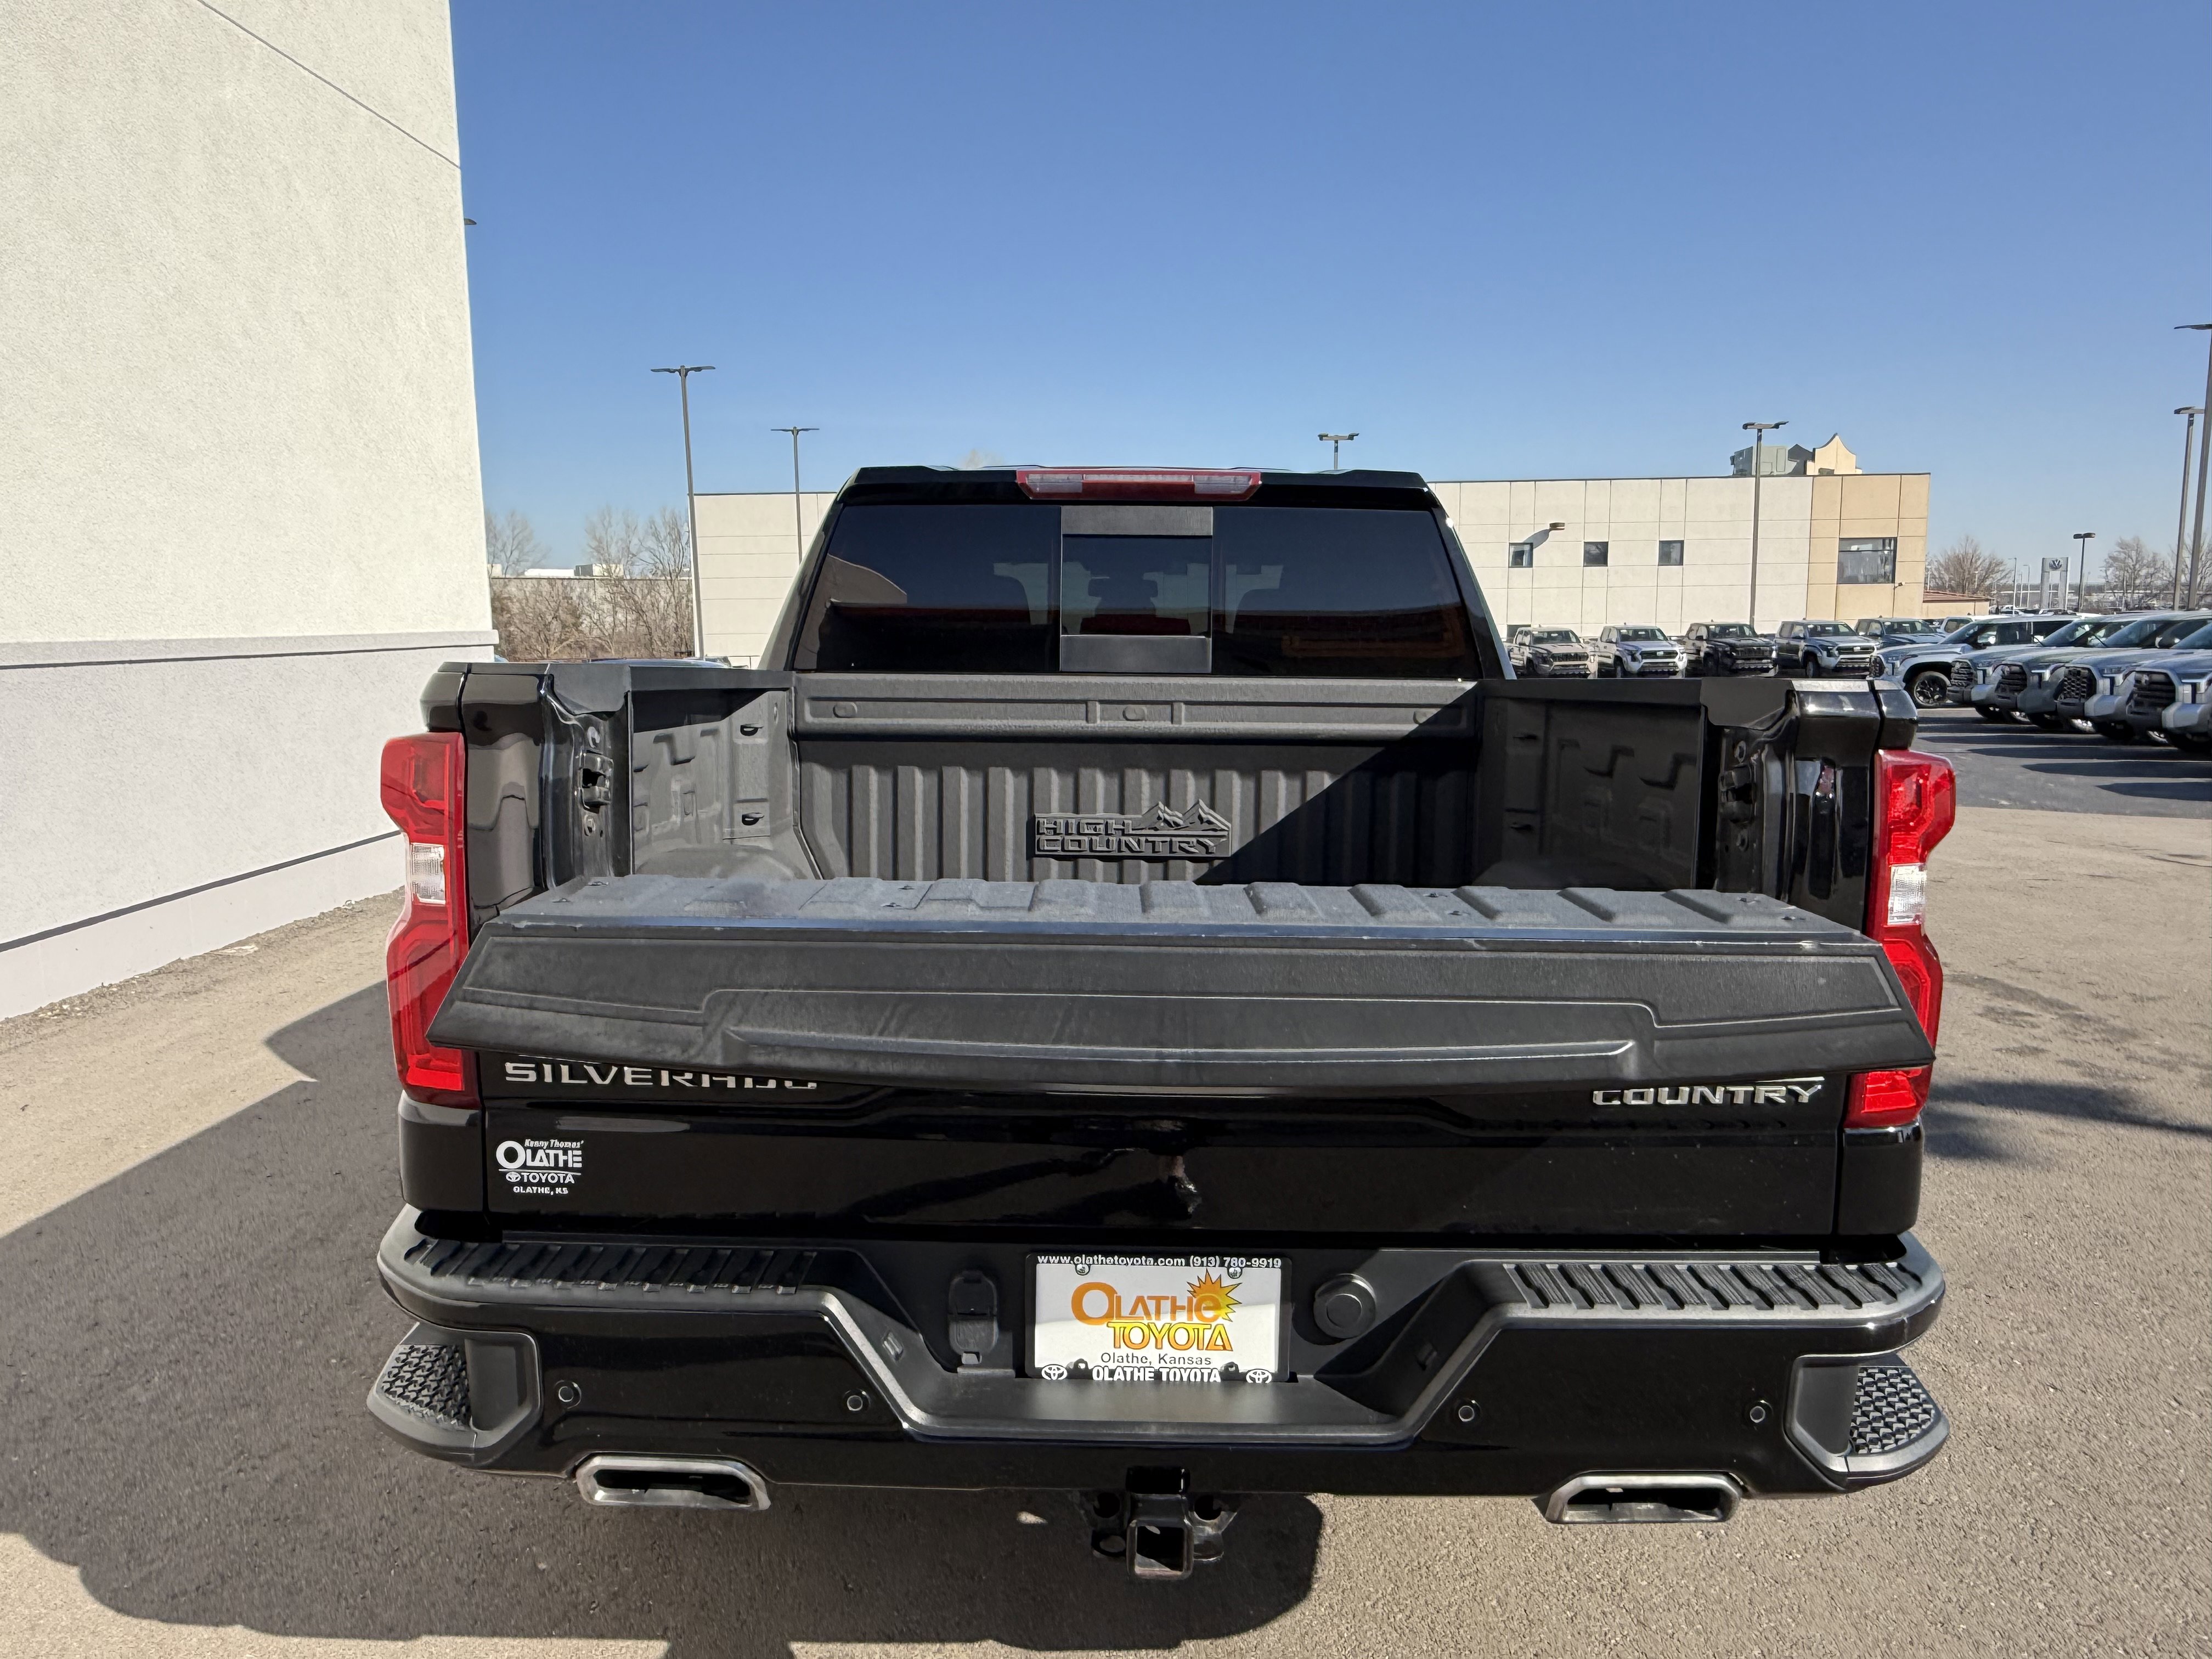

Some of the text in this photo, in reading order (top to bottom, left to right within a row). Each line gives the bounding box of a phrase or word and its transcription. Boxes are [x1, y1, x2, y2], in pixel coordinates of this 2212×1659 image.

[1037, 818, 1132, 836] HIGH
[1037, 836, 1227, 854] COUNTRY
[1592, 1084, 1822, 1105] COUNTRY
[496, 1141, 583, 1169] OLATHE
[521, 1172, 575, 1183] TOYOTA
[513, 1186, 554, 1195] OLATHE,
[1037, 1254, 1186, 1267] www.olathetoyota.com
[1189, 1255, 1220, 1268] (913)
[1107, 1321, 1234, 1351] TOYOTA
[1101, 1352, 1212, 1365] Olathe, Kansas
[1092, 1365, 1221, 1383] OLATHE TOYOTA
